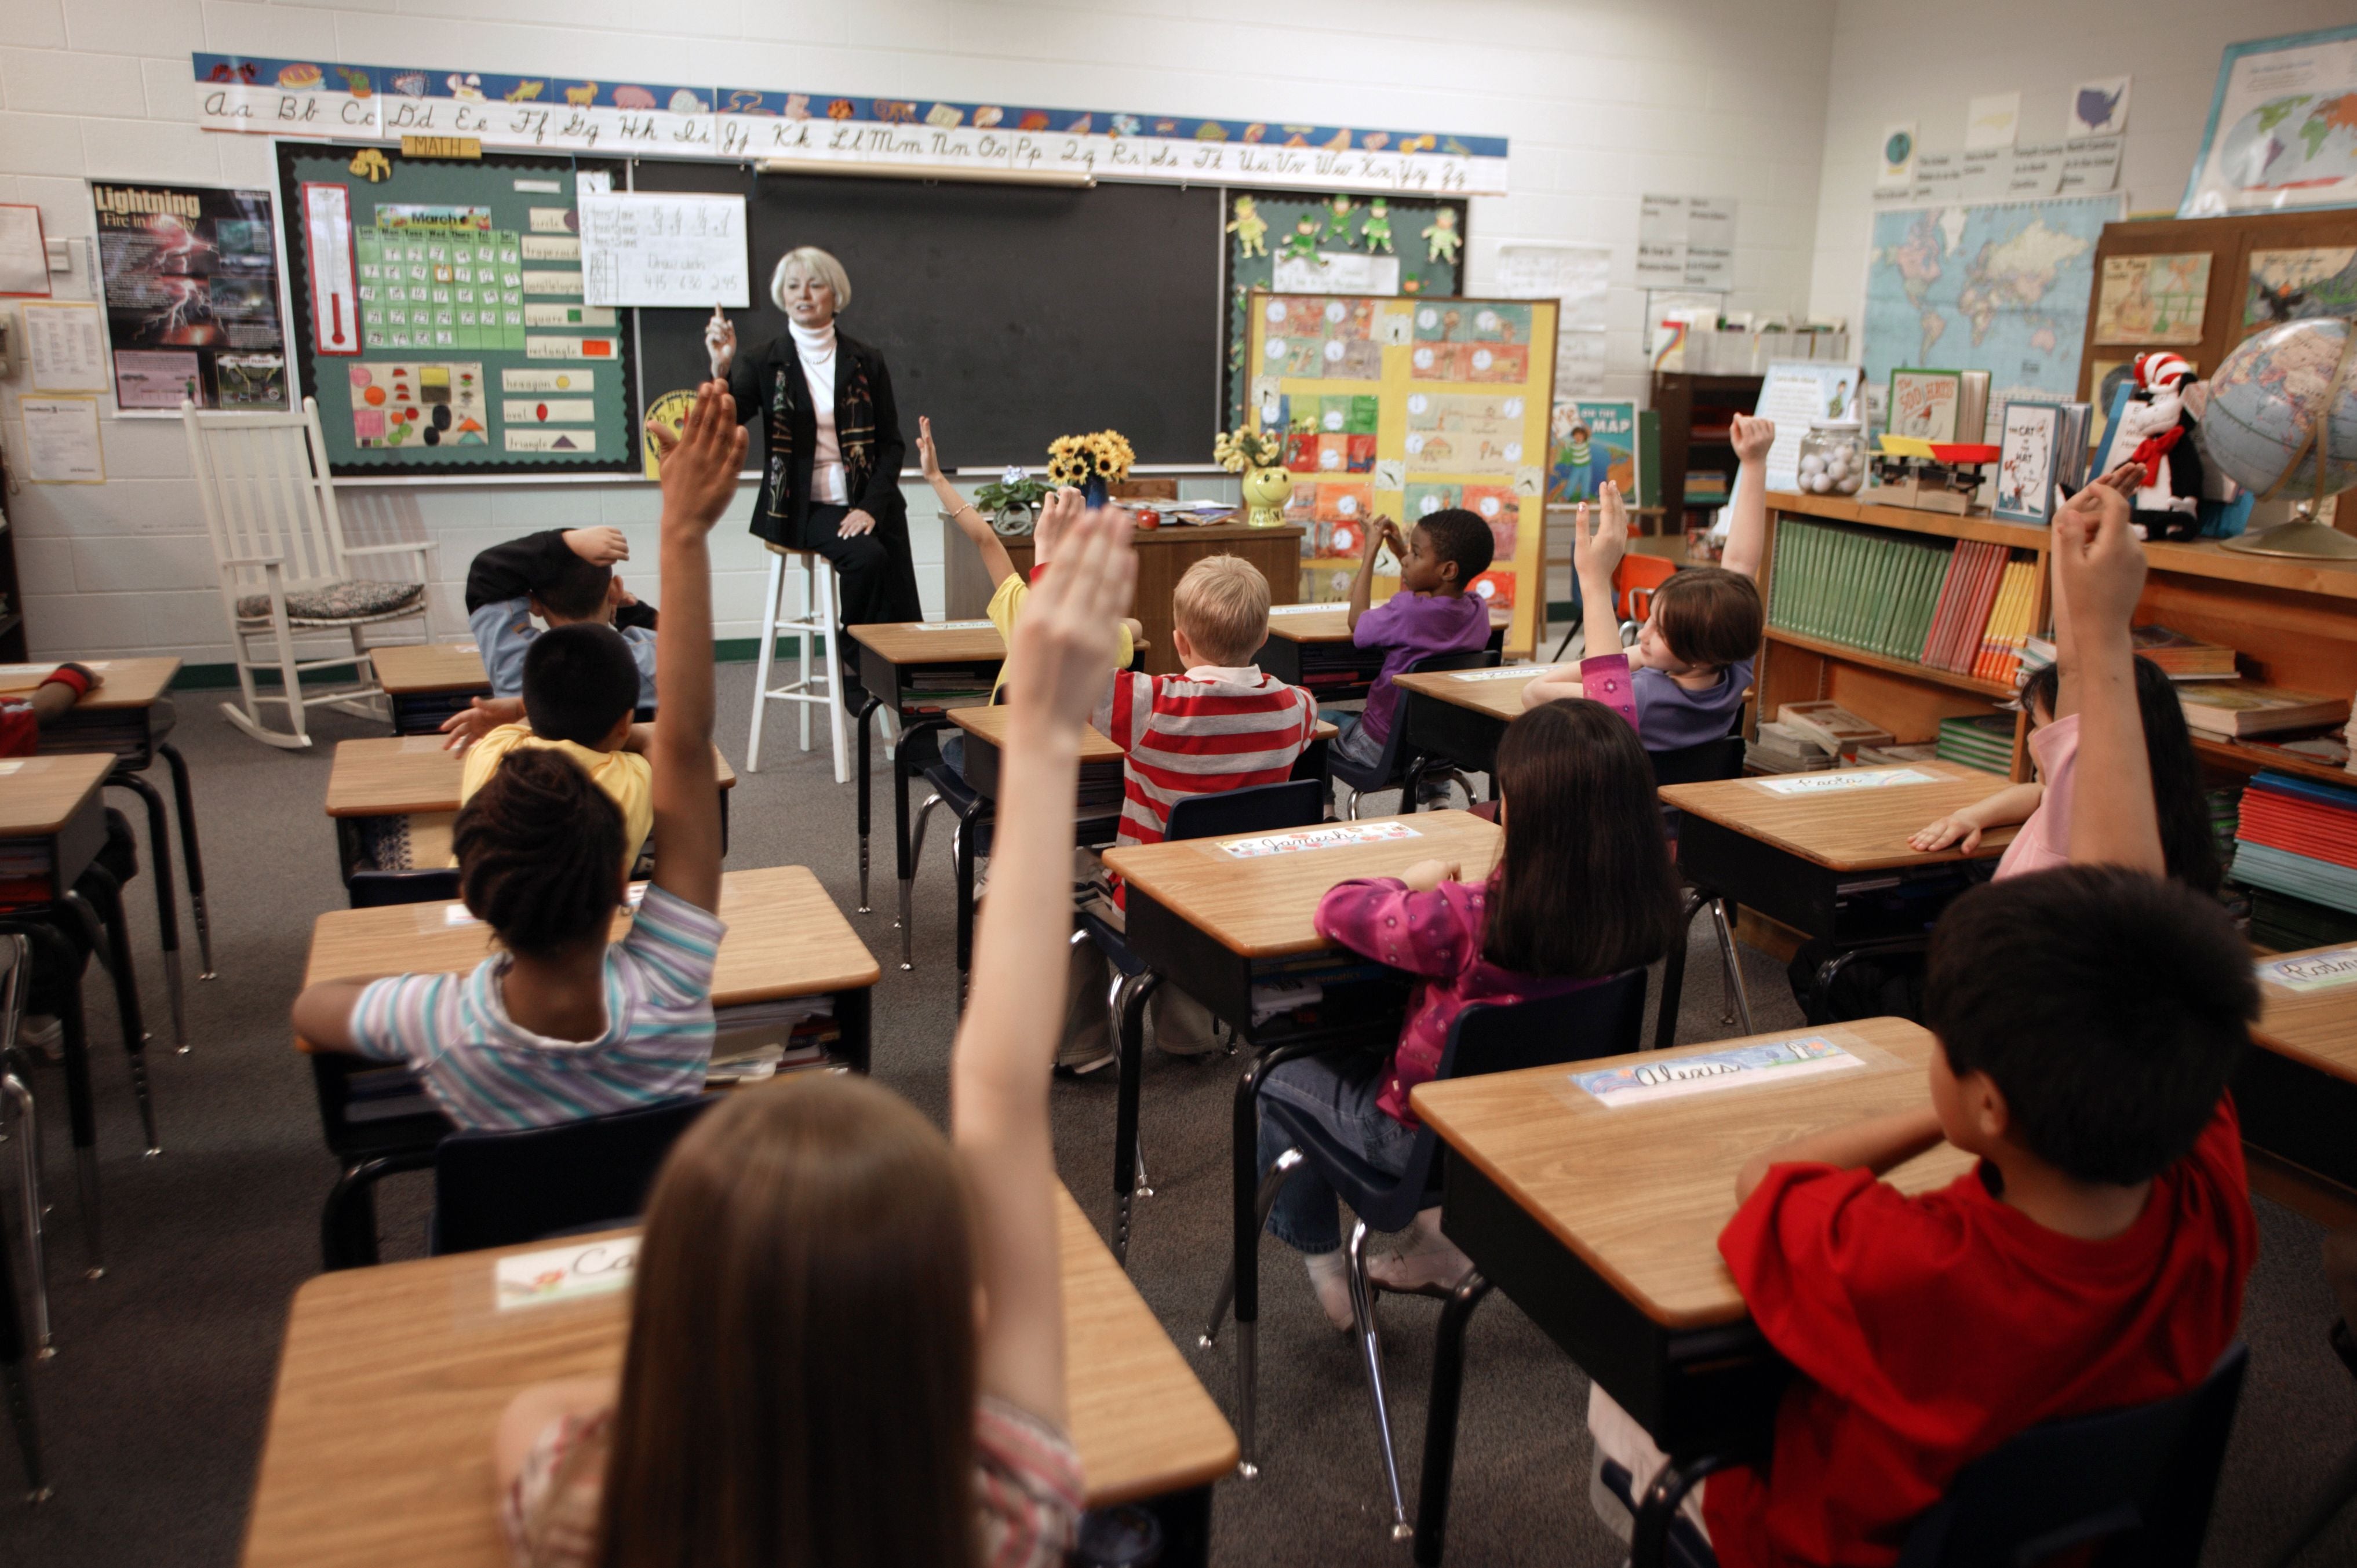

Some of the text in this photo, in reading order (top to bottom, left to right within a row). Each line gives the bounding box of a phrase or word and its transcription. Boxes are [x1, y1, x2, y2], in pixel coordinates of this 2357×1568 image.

[205, 92, 253, 118] Aa
[278, 96, 319, 122] Bb
[342, 100, 377, 126] Cc
[388, 103, 435, 130] Dd
[454, 107, 488, 133] Ee
[509, 108, 547, 142] Ff
[560, 112, 599, 147] Gg
[618, 114, 658, 141] Hh
[674, 116, 711, 144] Ii
[722, 121, 751, 154] Jj
[773, 123, 811, 149] Kk
[828, 126, 863, 152] Ll
[870, 127, 924, 154] Mm
[931, 132, 971, 157] Nn
[978, 134, 1009, 159] Oo
[1014, 137, 1043, 169] Pp
[1110, 142, 1142, 167] Rr
[1149, 145, 1179, 167] Ss
[1193, 147, 1222, 170] Tt
[1238, 149, 1270, 173] Uu
[1276, 152, 1306, 173] Vv
[1314, 154, 1353, 177] Ww
[1358, 156, 1391, 180] Xx
[1399, 158, 1429, 185] Yy
[1441, 162, 1467, 191] Zz
[414, 138, 462, 156] MATH
[94, 185, 201, 219] Lightning
[104, 213, 130, 227] Fire
[133, 213, 145, 227] in
[411, 212, 457, 225] March
[524, 244, 578, 261] trapezoid
[527, 312, 563, 327] square
[529, 342, 577, 359] rectangle
[505, 376, 551, 392] hexagon
[506, 407, 527, 420] oval
[668, 402, 676, 412] 11
[1581, 408, 1617, 418] ON THE
[1591, 420, 1631, 434] MAP
[2019, 426, 2035, 436] CAT
[509, 436, 547, 452] triangle
[2016, 453, 2032, 462] HAT
[2283, 958, 2357, 978] Rodn
[1635, 1063, 1741, 1086] Alexis
[572, 1246, 637, 1275] Ca
